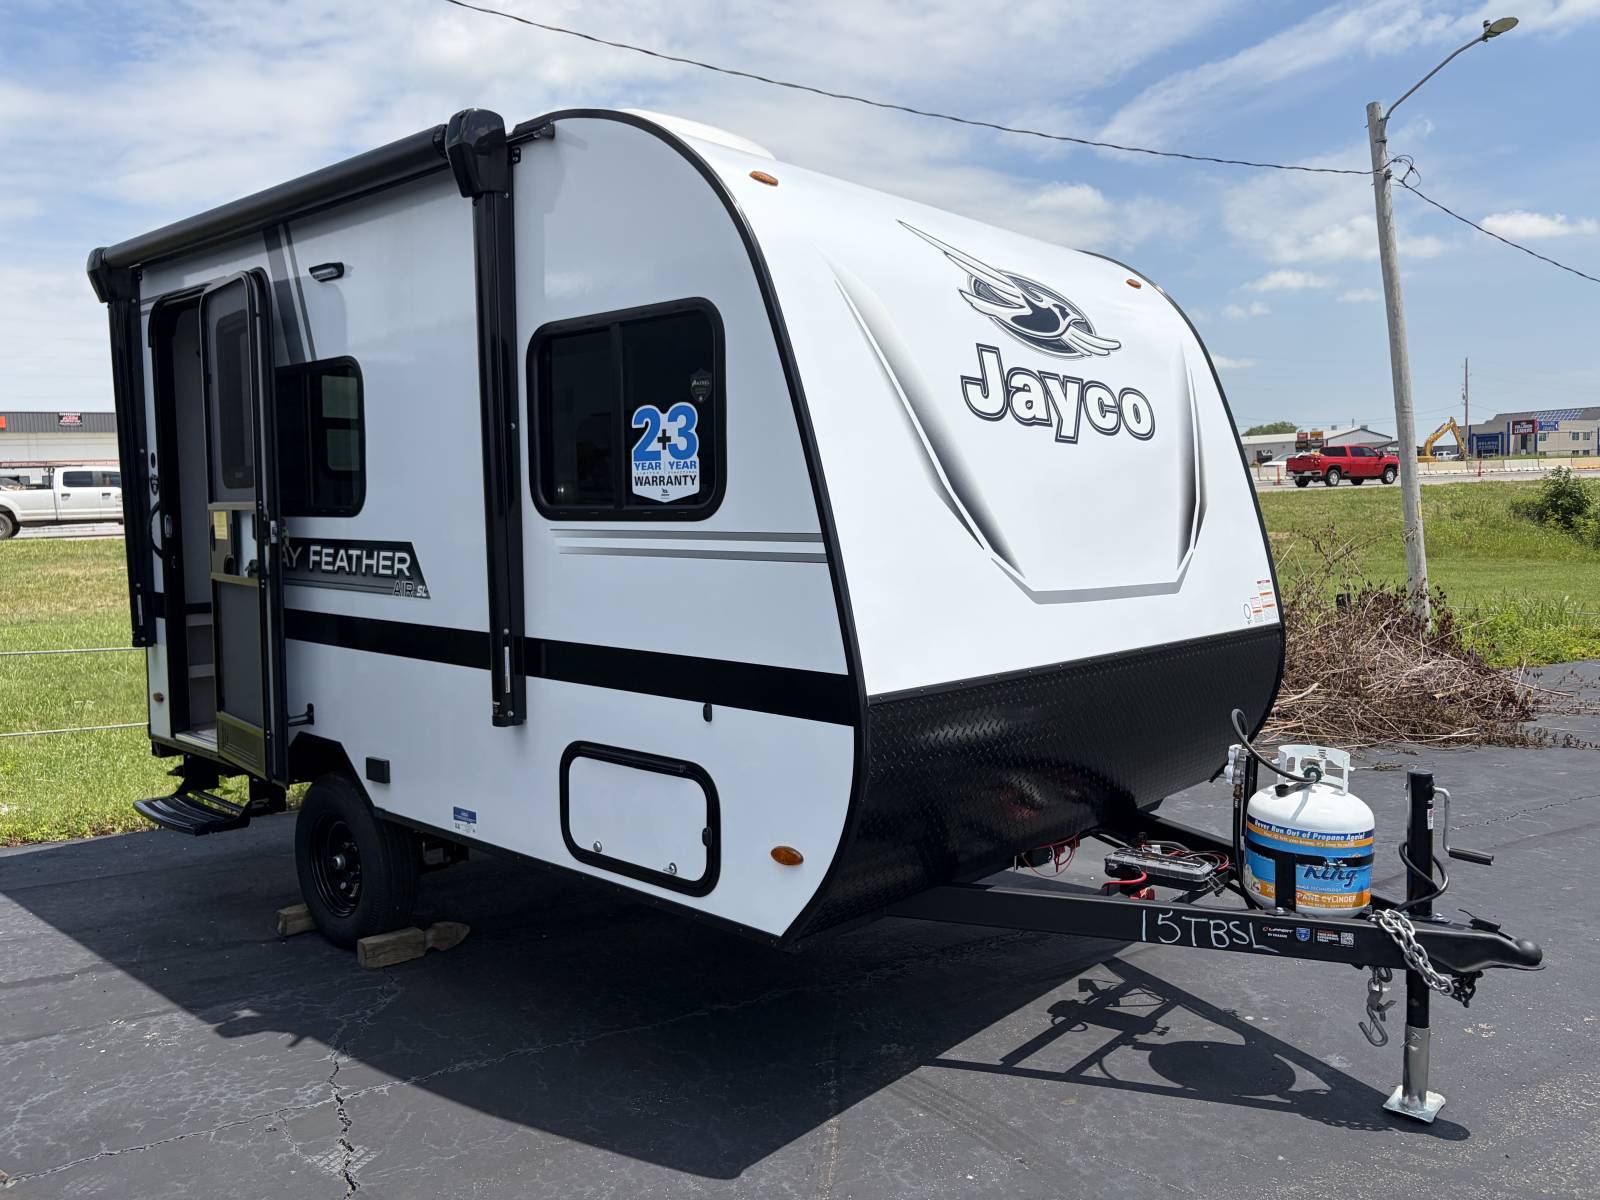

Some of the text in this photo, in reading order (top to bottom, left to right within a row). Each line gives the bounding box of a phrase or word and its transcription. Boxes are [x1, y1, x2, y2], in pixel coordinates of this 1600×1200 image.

[960, 343, 1155, 444] Jayco
[634, 460, 697, 471] YEAR YEAR
[634, 475, 697, 487] WARRANTY
[281, 545, 411, 577] AY FEATHER
[392, 580, 415, 598] AIR
[1271, 826, 1284, 835] Run
[1286, 828, 1300, 838] Out
[1301, 830, 1310, 839] of
[1312, 832, 1344, 842] Propane
[1346, 832, 1365, 842] Again!
[1321, 894, 1357, 904] CYLINDER
